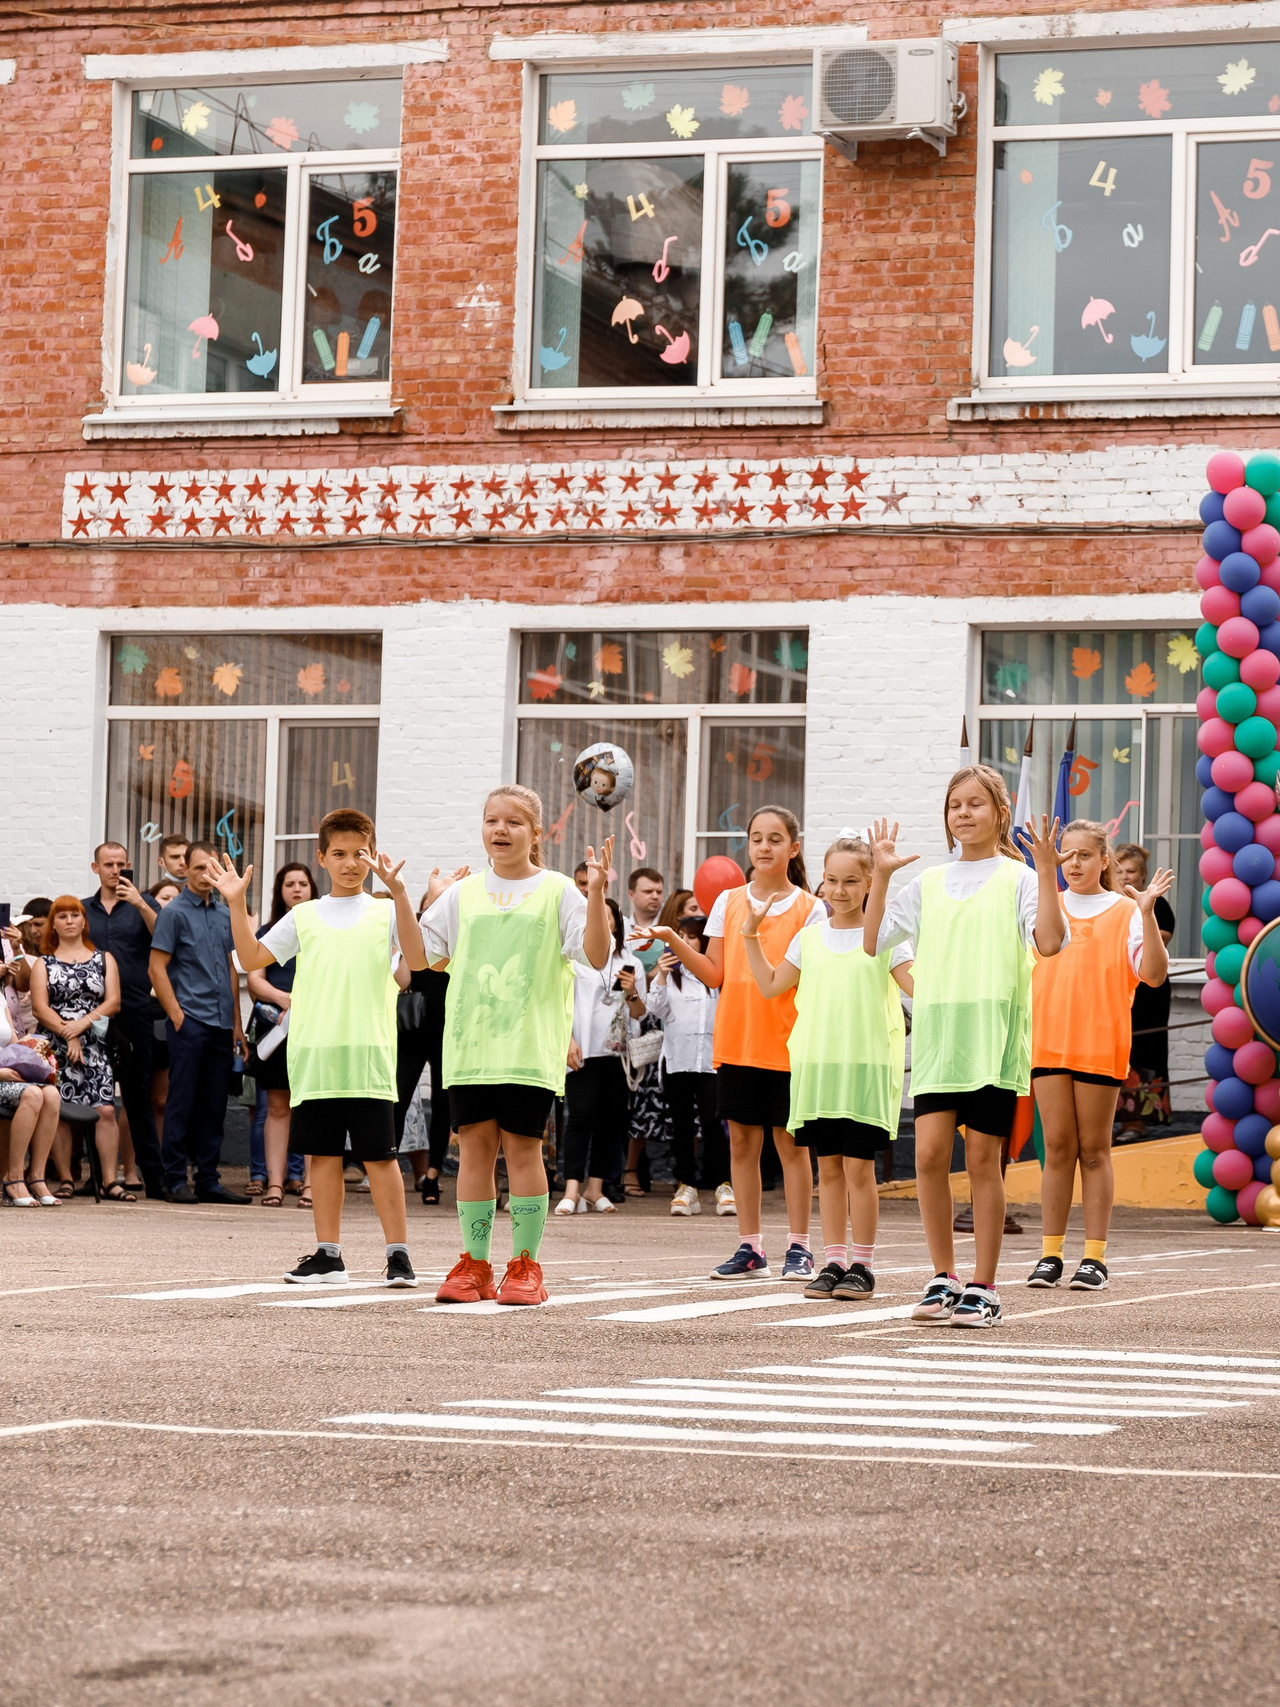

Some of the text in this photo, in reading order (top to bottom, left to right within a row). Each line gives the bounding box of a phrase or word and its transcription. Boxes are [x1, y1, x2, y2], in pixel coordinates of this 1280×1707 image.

[1089, 160, 1117, 196] 4
[1243, 158, 1274, 199] 5
[353, 197, 377, 237] 5
[766, 188, 791, 228] 5
[169, 760, 194, 798] 5
[332, 761, 355, 790] 4
[746, 742, 777, 782] 5
[1068, 754, 1099, 796] 5
